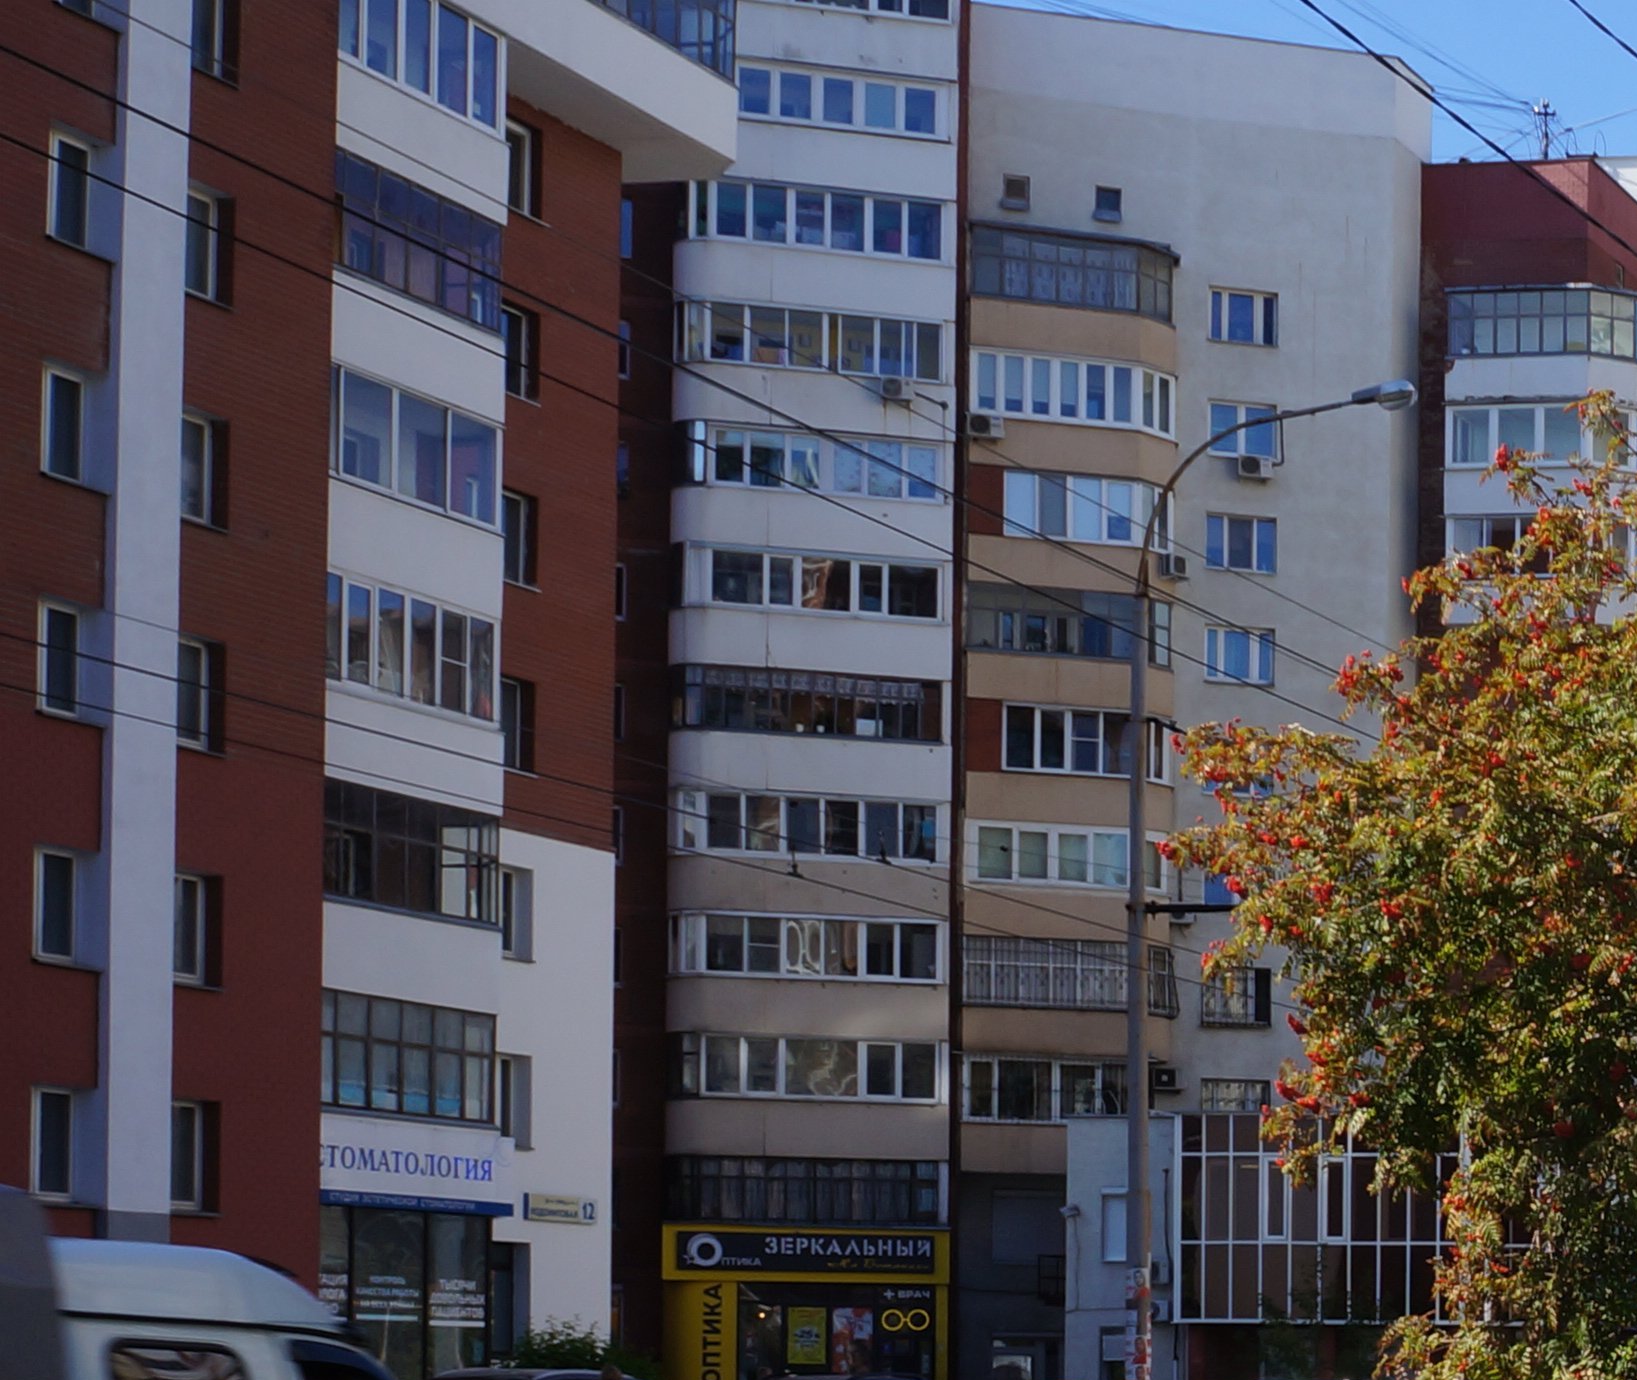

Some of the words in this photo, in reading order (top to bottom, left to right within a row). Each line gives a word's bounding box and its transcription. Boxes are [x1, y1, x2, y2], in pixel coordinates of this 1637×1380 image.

[582, 1202, 596, 1221] 12
[764, 1236, 932, 1258] ЗЕРКАЛЬНЫЙ
[897, 1289, 931, 1299] ВРАЧ
